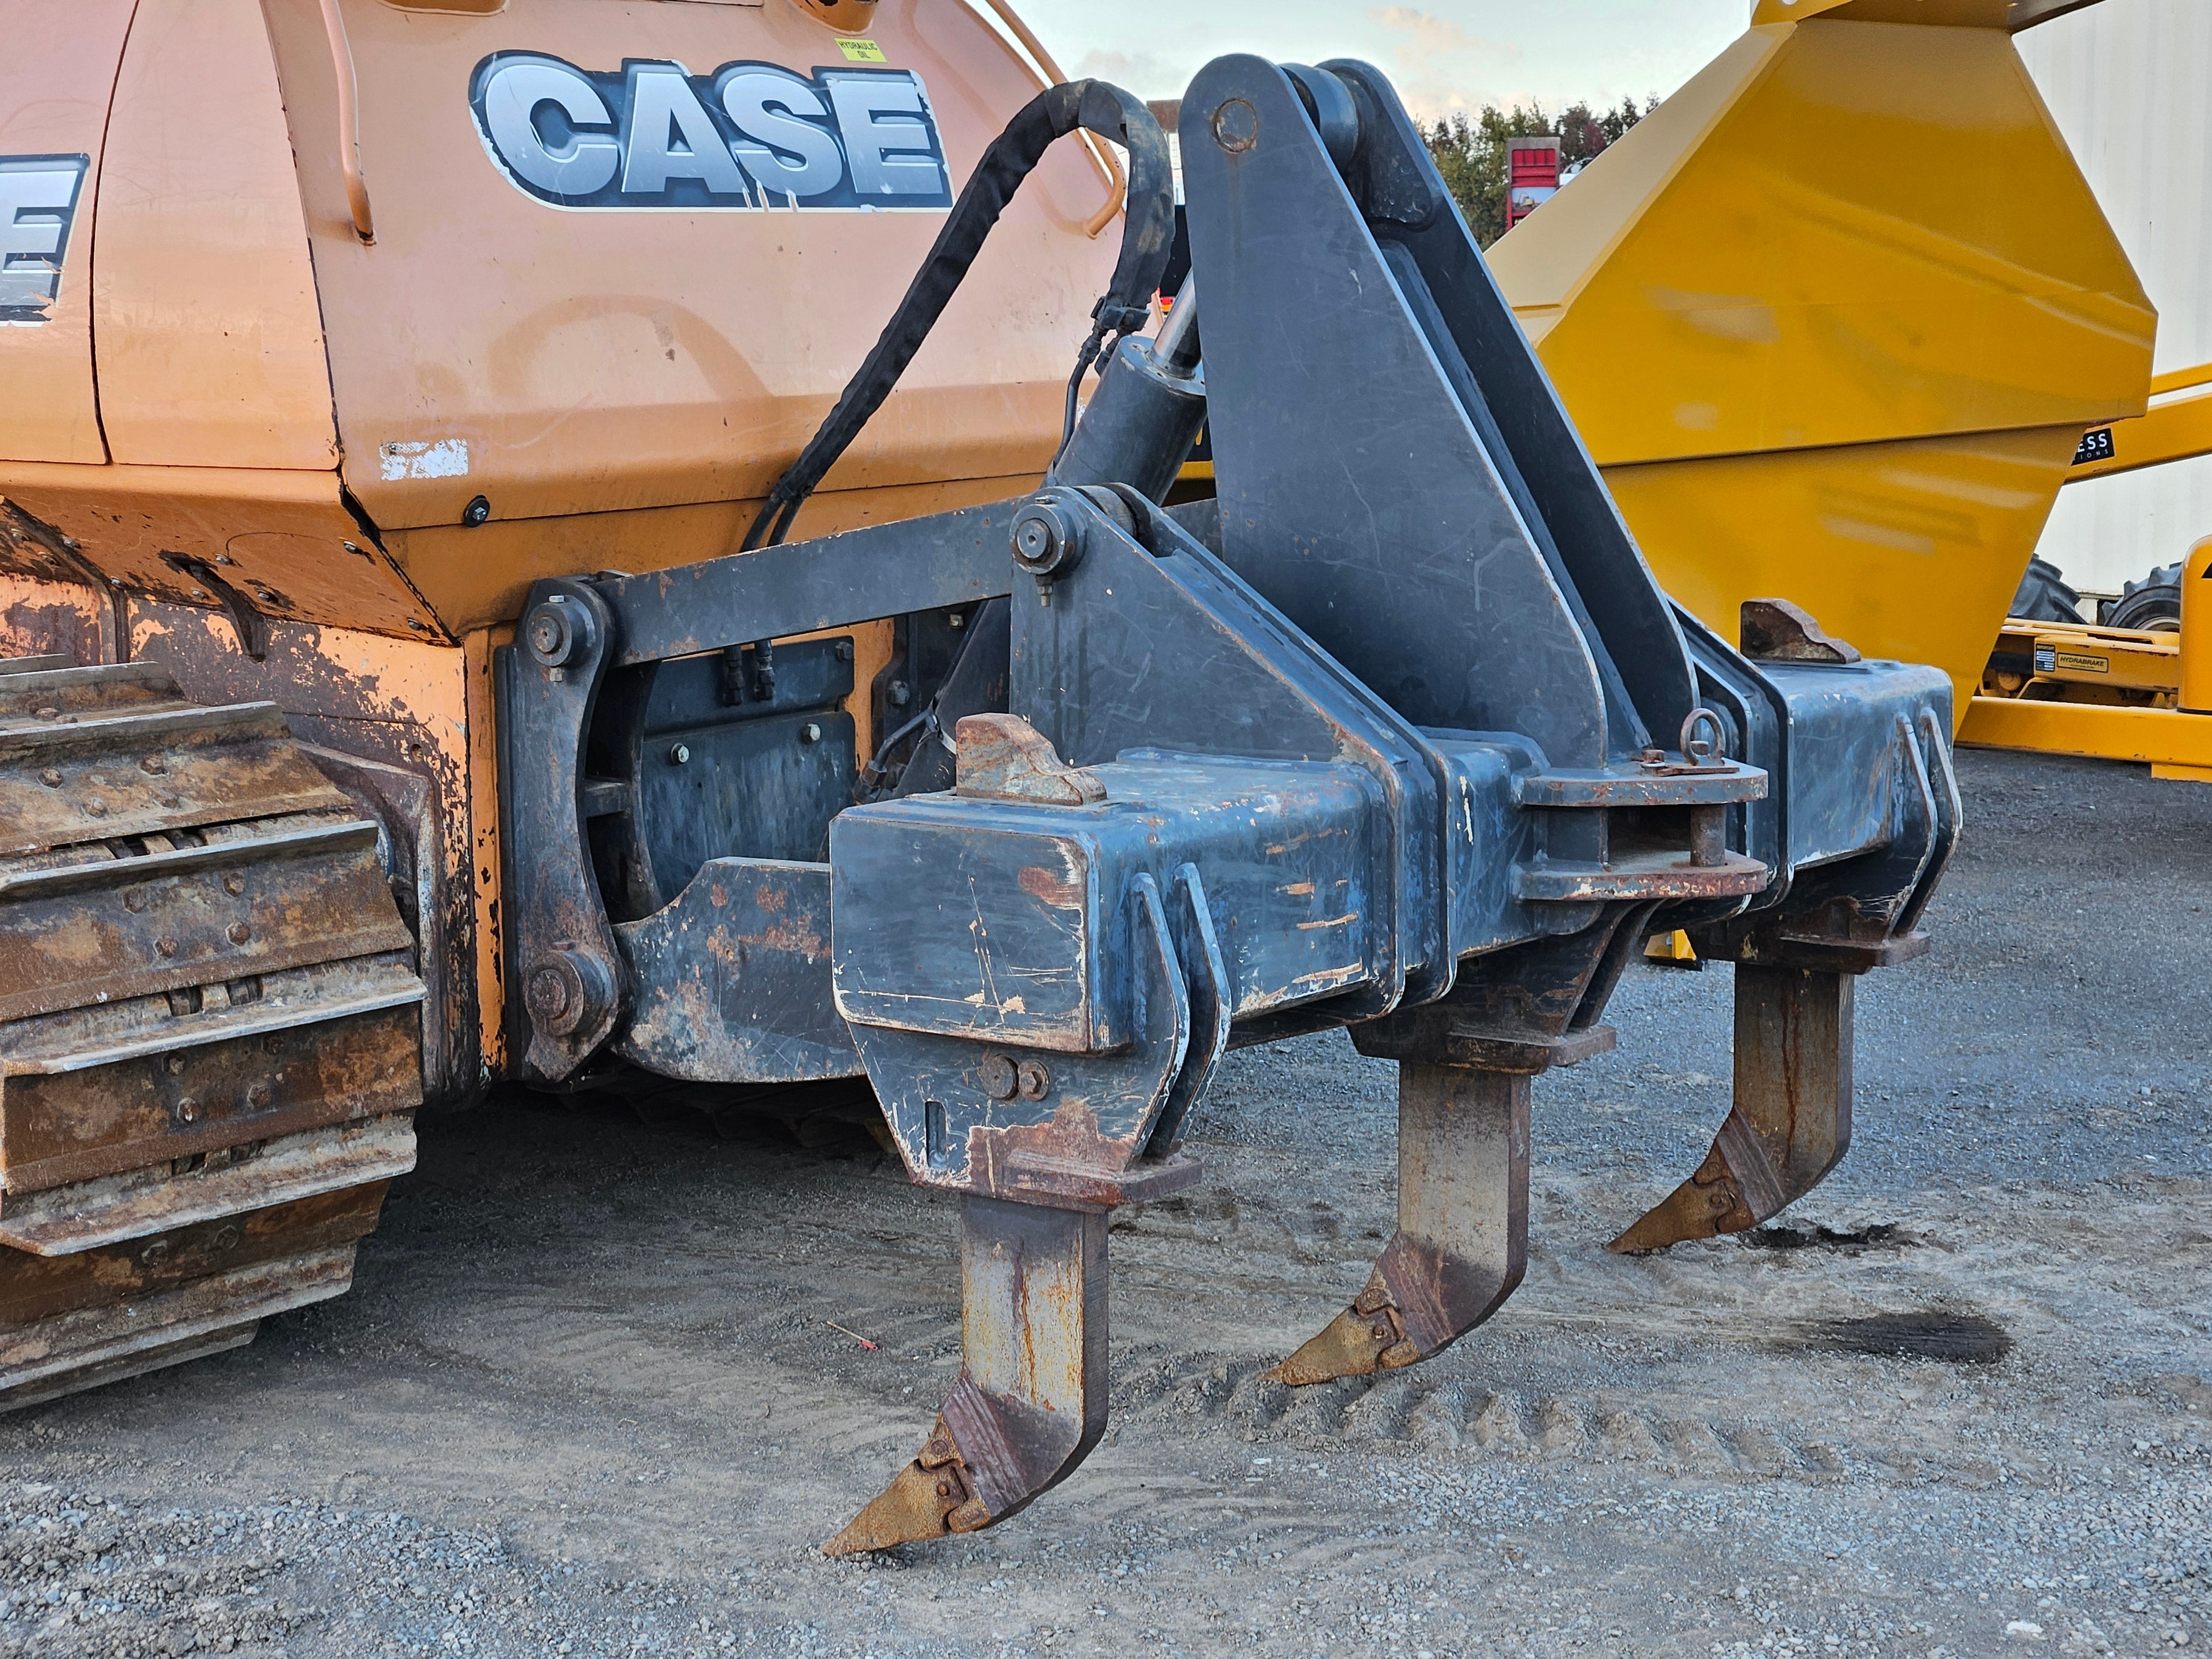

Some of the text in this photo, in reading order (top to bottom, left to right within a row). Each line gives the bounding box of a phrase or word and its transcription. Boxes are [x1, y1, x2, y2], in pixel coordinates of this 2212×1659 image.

[838, 41, 877, 50] HYDRAULIC
[486, 64, 943, 196] CASE
[2080, 449, 2108, 460] IONS
[2060, 657, 2104, 666] HYDRABRAKE
